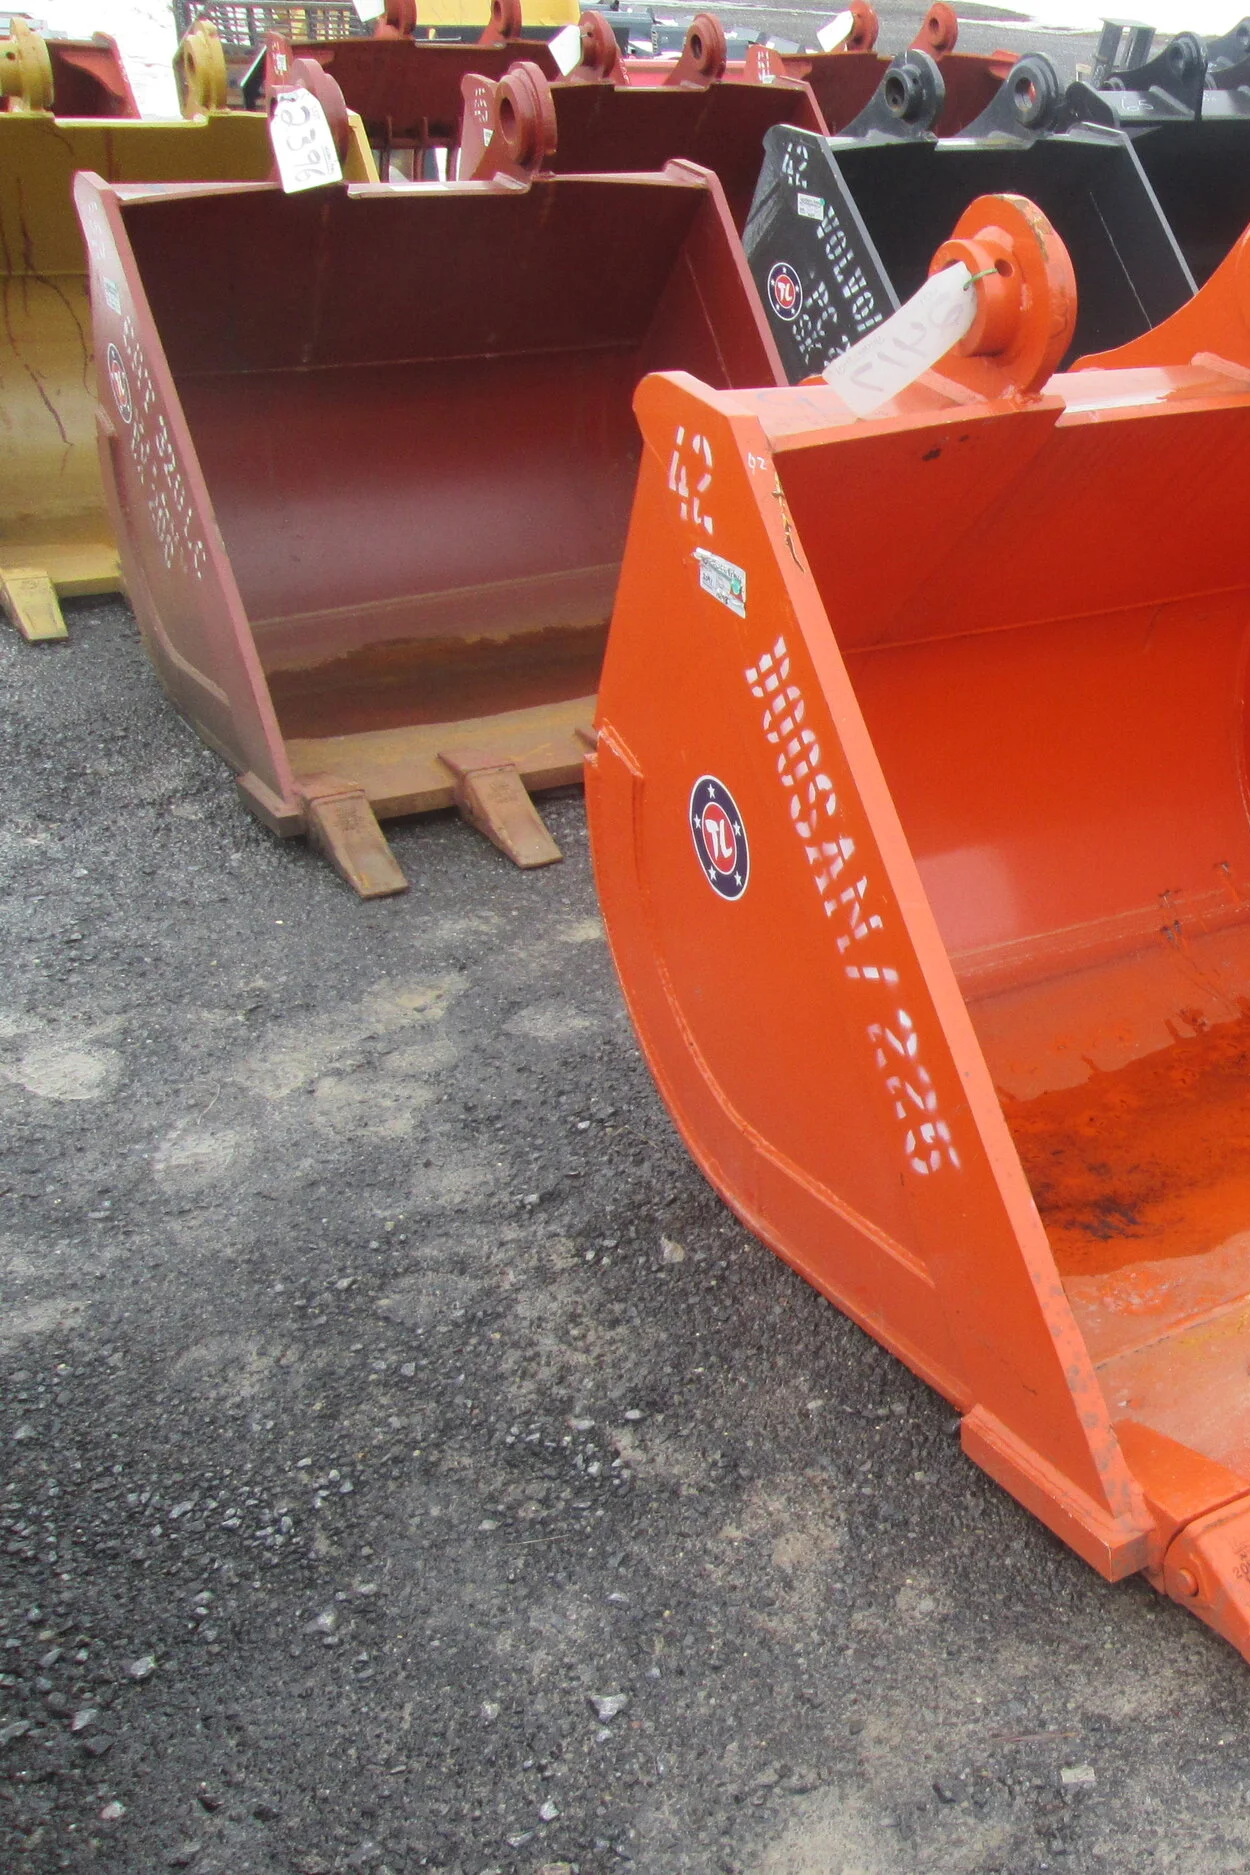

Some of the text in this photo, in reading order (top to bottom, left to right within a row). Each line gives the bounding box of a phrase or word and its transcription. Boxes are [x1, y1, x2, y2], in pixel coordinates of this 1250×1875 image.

[781, 142, 809, 189] 42
[667, 425, 713, 535] 42
[867, 1007, 963, 1176] 225
